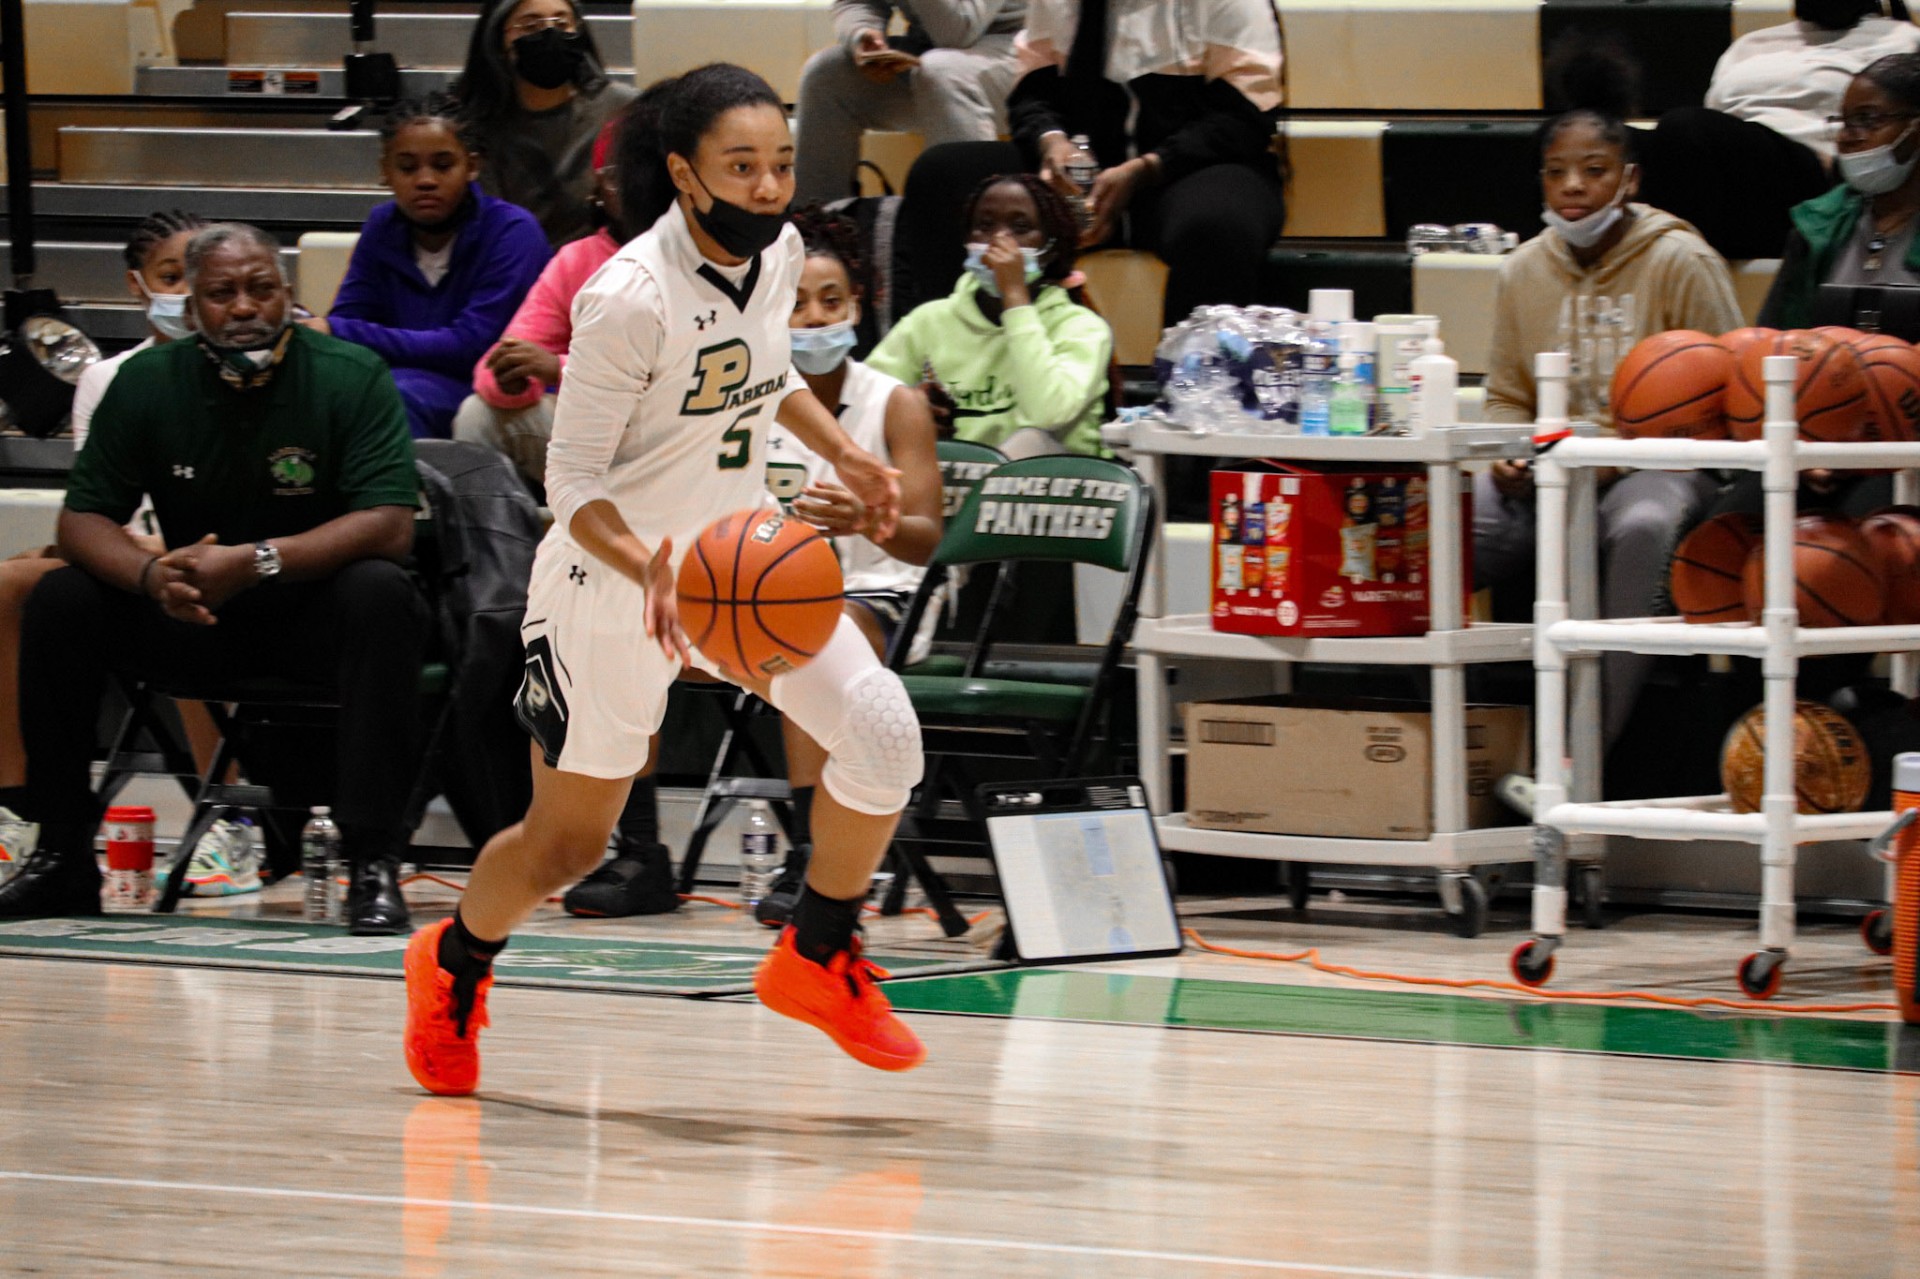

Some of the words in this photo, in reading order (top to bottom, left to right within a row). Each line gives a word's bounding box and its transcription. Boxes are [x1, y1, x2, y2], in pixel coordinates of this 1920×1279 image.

[679, 338, 788, 416] PARKDA
[717, 403, 764, 469] 5
[980, 477, 1050, 496] HOME
[1050, 478, 1083, 498] OF
[1081, 479, 1132, 502] THE
[974, 501, 1117, 539] PANTHERS
